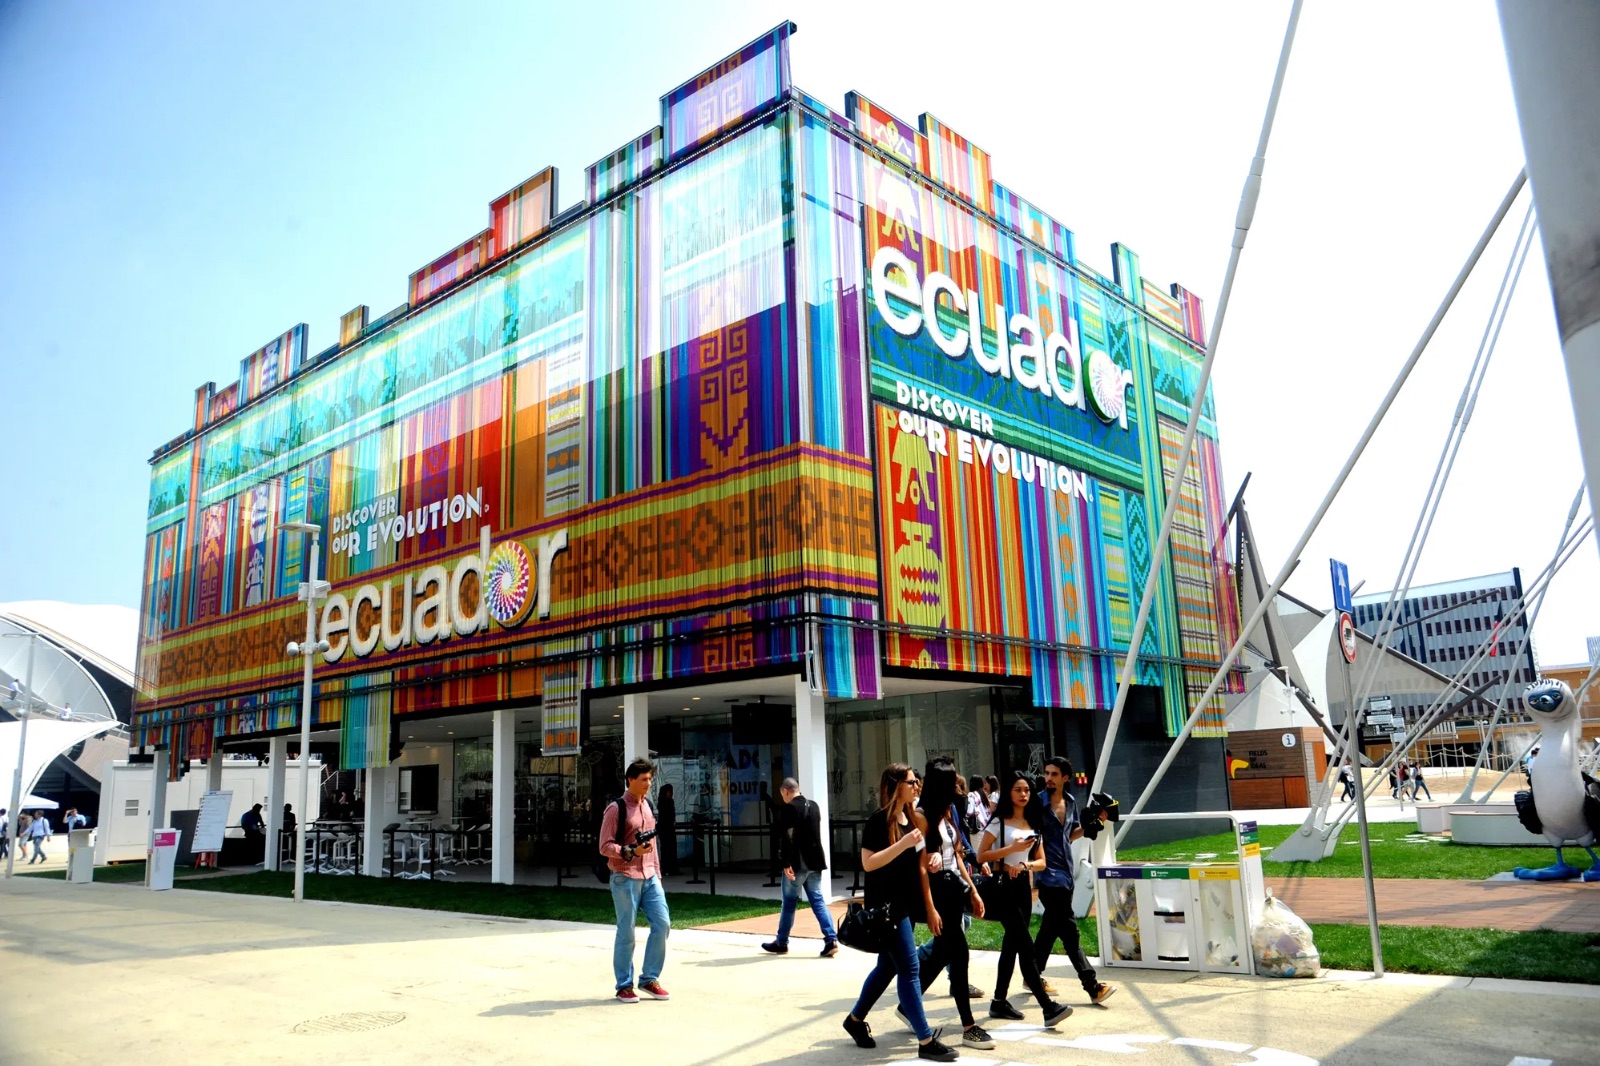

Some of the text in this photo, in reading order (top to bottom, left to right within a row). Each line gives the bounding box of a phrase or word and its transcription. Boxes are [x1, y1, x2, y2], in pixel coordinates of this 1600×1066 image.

[871, 246, 1134, 430] ecuador
[895, 380, 994, 436] DISCOVER
[897, 410, 949, 457] OUR
[333, 496, 396, 535] DISCOVER
[332, 531, 361, 558] OUR
[319, 525, 569, 664] ecuador
